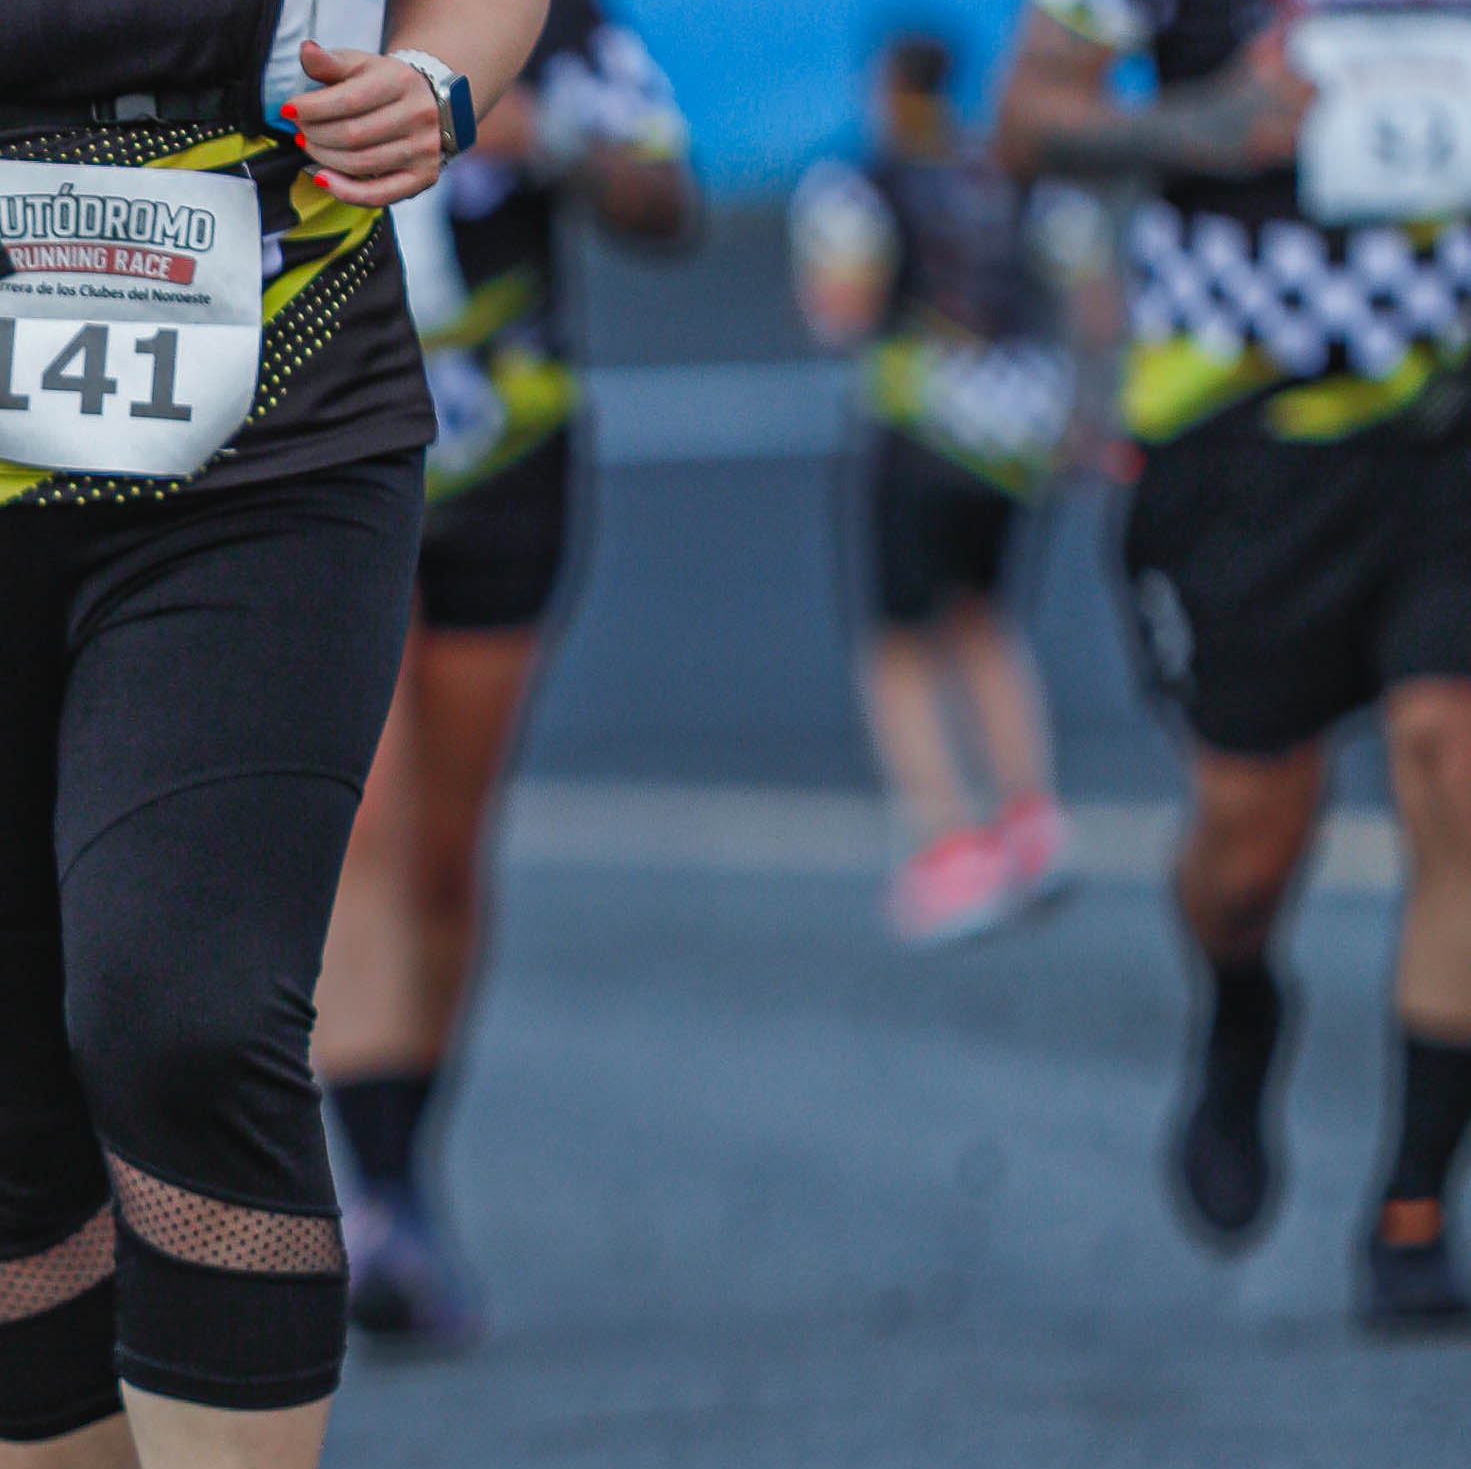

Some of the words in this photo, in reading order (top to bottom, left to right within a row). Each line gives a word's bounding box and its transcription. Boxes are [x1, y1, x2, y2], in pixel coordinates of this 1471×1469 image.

[11, 244, 108, 270] RUNNING
[113, 249, 173, 278] RACE
[36, 281, 53, 295] de
[56, 282, 76, 296] los
[79, 283, 124, 299] Clubes
[128, 287, 148, 300] del
[151, 288, 212, 305] Noroeste
